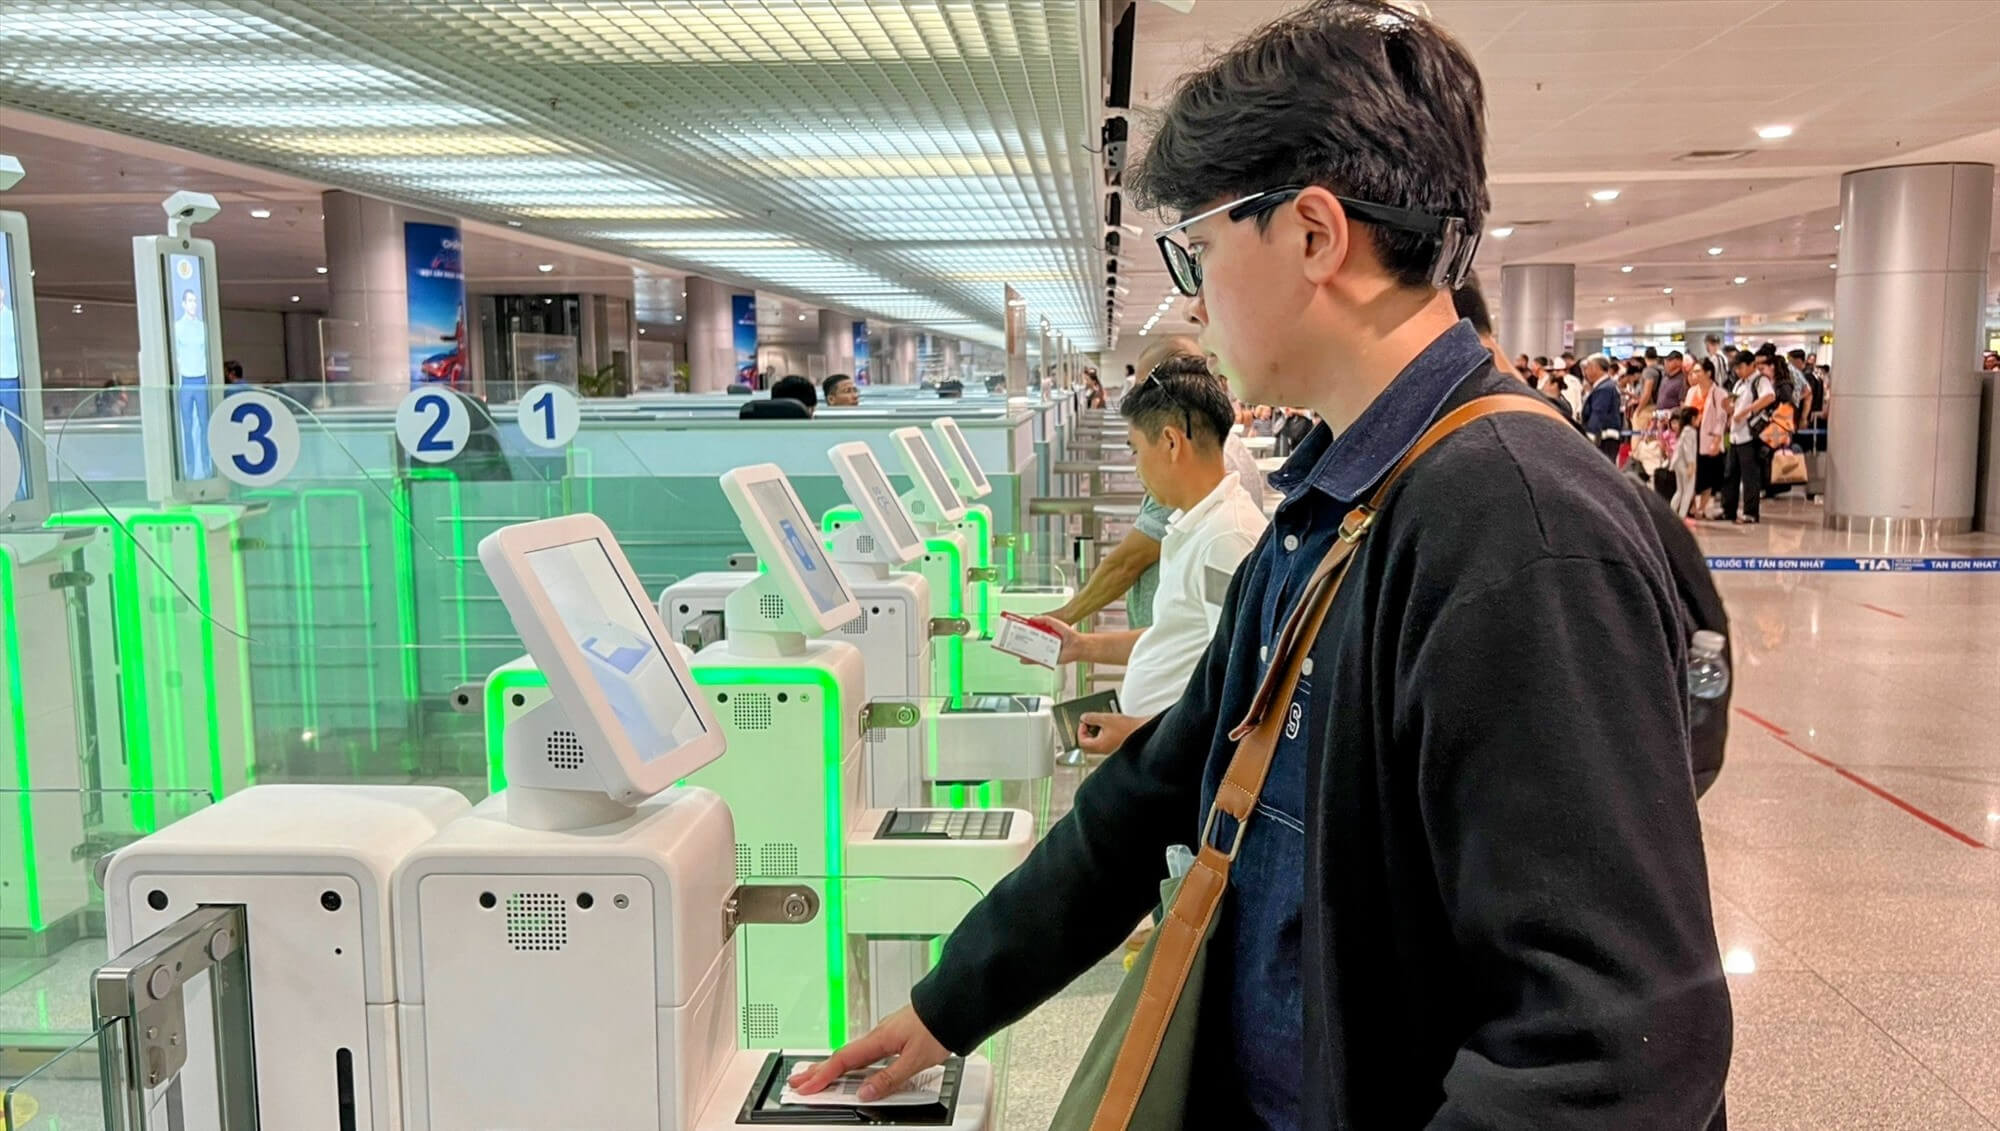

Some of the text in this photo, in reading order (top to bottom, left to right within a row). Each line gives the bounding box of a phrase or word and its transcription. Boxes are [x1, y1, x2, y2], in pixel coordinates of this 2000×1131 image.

[413, 394, 454, 452] 2
[532, 392, 556, 440] 1
[230, 402, 278, 475] 3
[1855, 558, 1890, 571] TIA
[1931, 561, 1949, 569] TAN
[1972, 561, 1998, 569] NHAT
[1286, 703, 1302, 739] S
